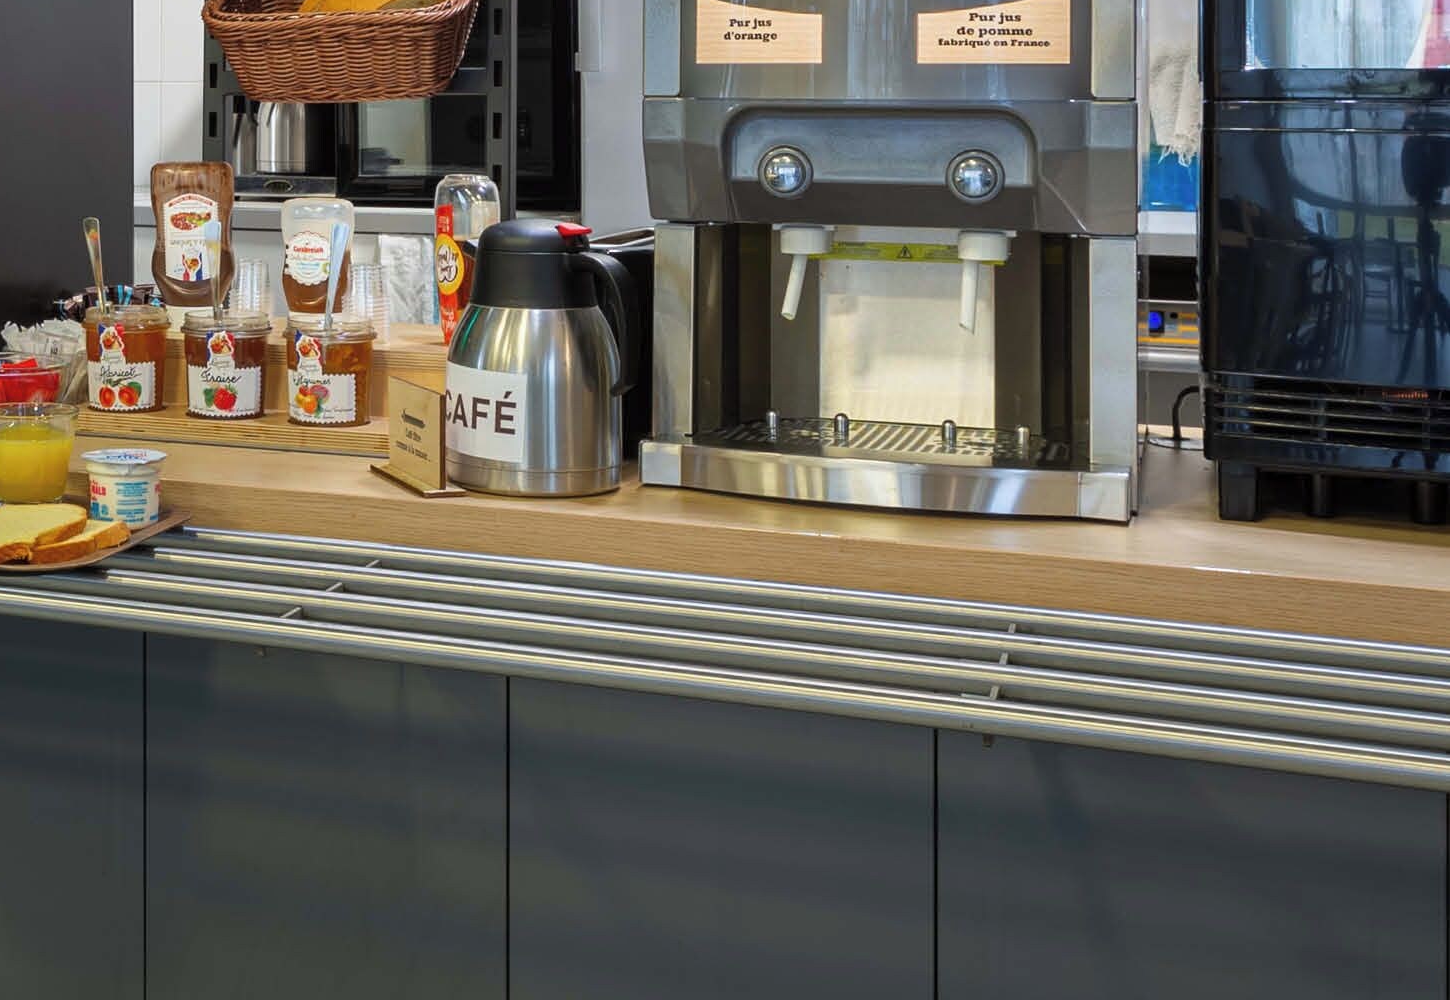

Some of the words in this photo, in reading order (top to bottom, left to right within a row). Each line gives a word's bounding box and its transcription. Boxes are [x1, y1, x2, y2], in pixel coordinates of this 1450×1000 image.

[729, 18, 751, 28] Pur
[752, 18, 772, 30] jus
[968, 12, 996, 23] Pur
[999, 11, 1022, 25] jus
[723, 30, 778, 42] d'orange
[956, 25, 975, 36] de
[978, 26, 1033, 38] pomme
[993, 39, 1008, 48] en
[1010, 38, 1051, 48] France
[201, 367, 242, 383] Fraise
